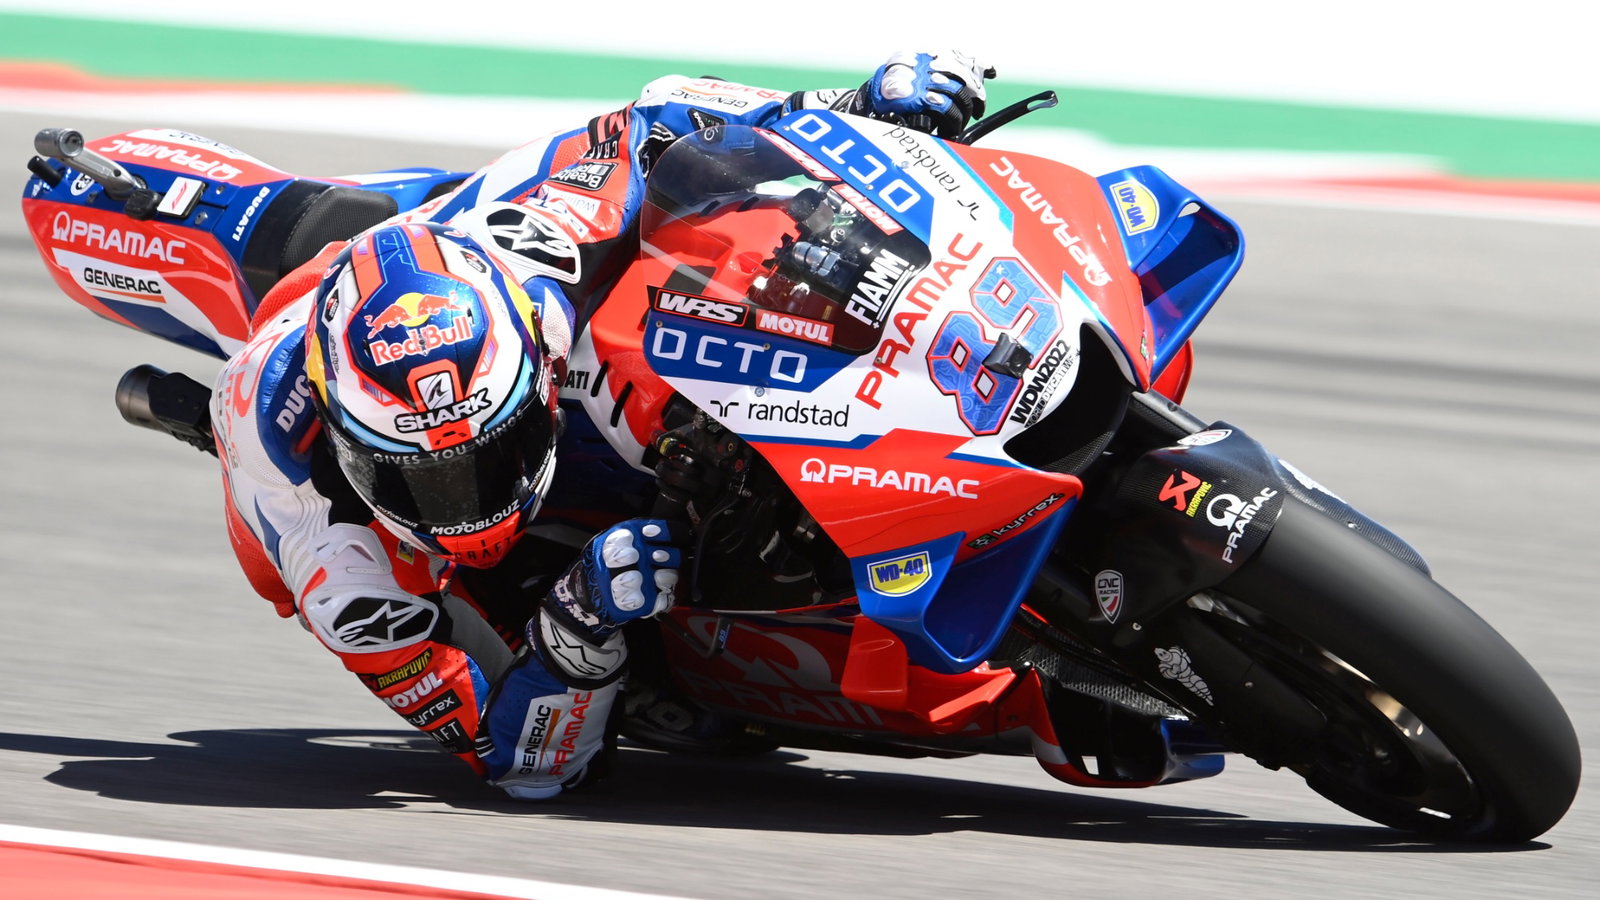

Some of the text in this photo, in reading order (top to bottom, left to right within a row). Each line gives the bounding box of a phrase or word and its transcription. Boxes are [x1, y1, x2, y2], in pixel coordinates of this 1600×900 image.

[789, 113, 921, 213] OCTO
[883, 127, 961, 193] randstad
[232, 187, 270, 242] DUCATI
[990, 156, 1091, 268] PRAMAC
[1118, 187, 1146, 228] WD-40
[70, 220, 186, 265] PRAMAC
[84, 267, 161, 295] GENERAC
[845, 249, 909, 327] FIAMM
[658, 293, 743, 322] WRS
[758, 312, 830, 343] MOTUL
[855, 233, 983, 411] PRAMAC
[369, 330, 423, 366] Red
[425, 316, 474, 351] Bull
[652, 327, 808, 383] OCTO
[926, 257, 1064, 436] 89
[275, 372, 312, 433] DUC
[564, 369, 590, 390] ATI
[1010, 339, 1071, 424] WDW2022
[373, 409, 524, 465] GIVES YOU WINGS
[396, 389, 492, 434] SHARK
[748, 400, 850, 428] randstad
[827, 465, 980, 499] PRAMAC
[430, 498, 521, 535] MOTOBLOUZ
[993, 492, 1062, 537] kyrrex
[1222, 487, 1278, 564] PRAMAC
[876, 557, 925, 583] WD-40
[1098, 578, 1119, 588] CNC
[674, 667, 884, 726] PRAM
[431, 721, 460, 742] AFT
[518, 704, 551, 775] GENERAC
[548, 692, 593, 776] PRAMAC
